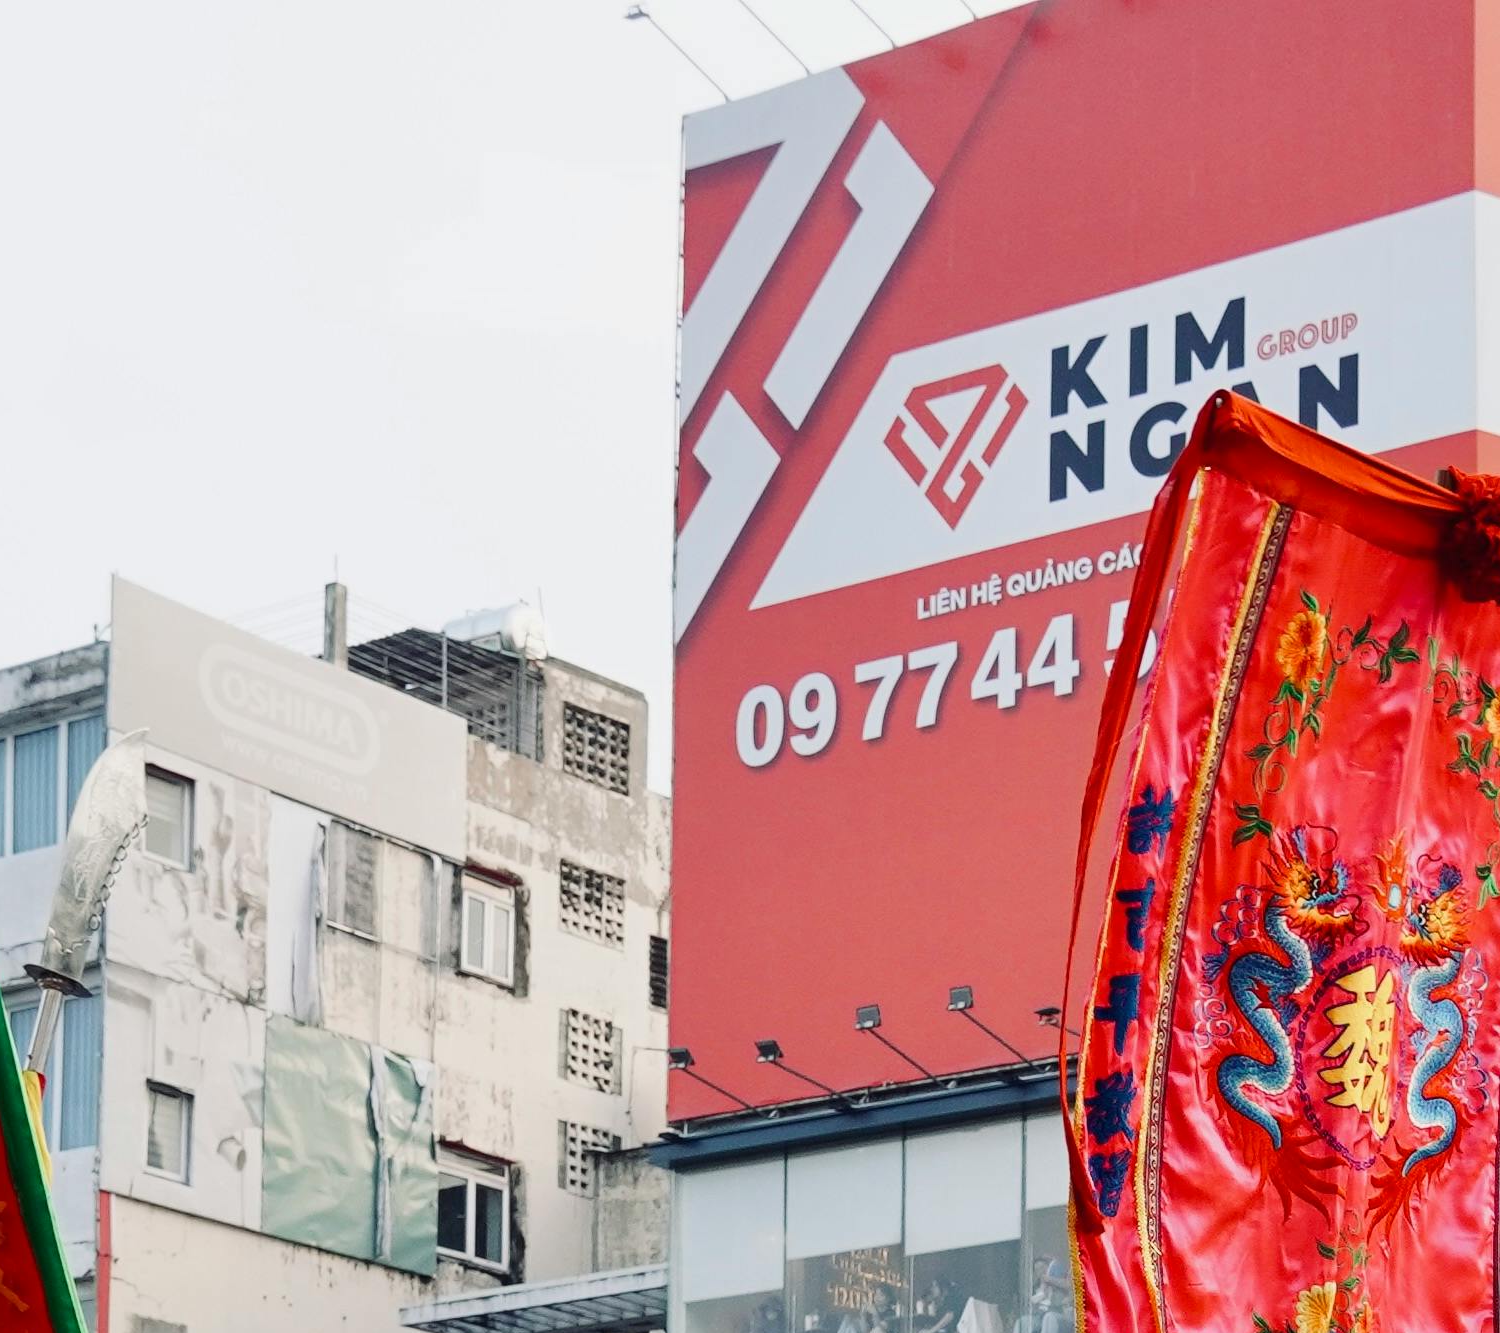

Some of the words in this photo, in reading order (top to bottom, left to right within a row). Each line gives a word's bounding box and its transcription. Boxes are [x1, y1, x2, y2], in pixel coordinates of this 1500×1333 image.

[1050, 297, 1246, 418] KIM
[1257, 312, 1358, 361] GROUP
[1049, 354, 1360, 503] NGN
[916, 586, 967, 621] LIÊN
[970, 572, 1003, 607] HỆ
[1005, 556, 1094, 598] QUẢNG
[220, 670, 357, 753] OSHIMA
